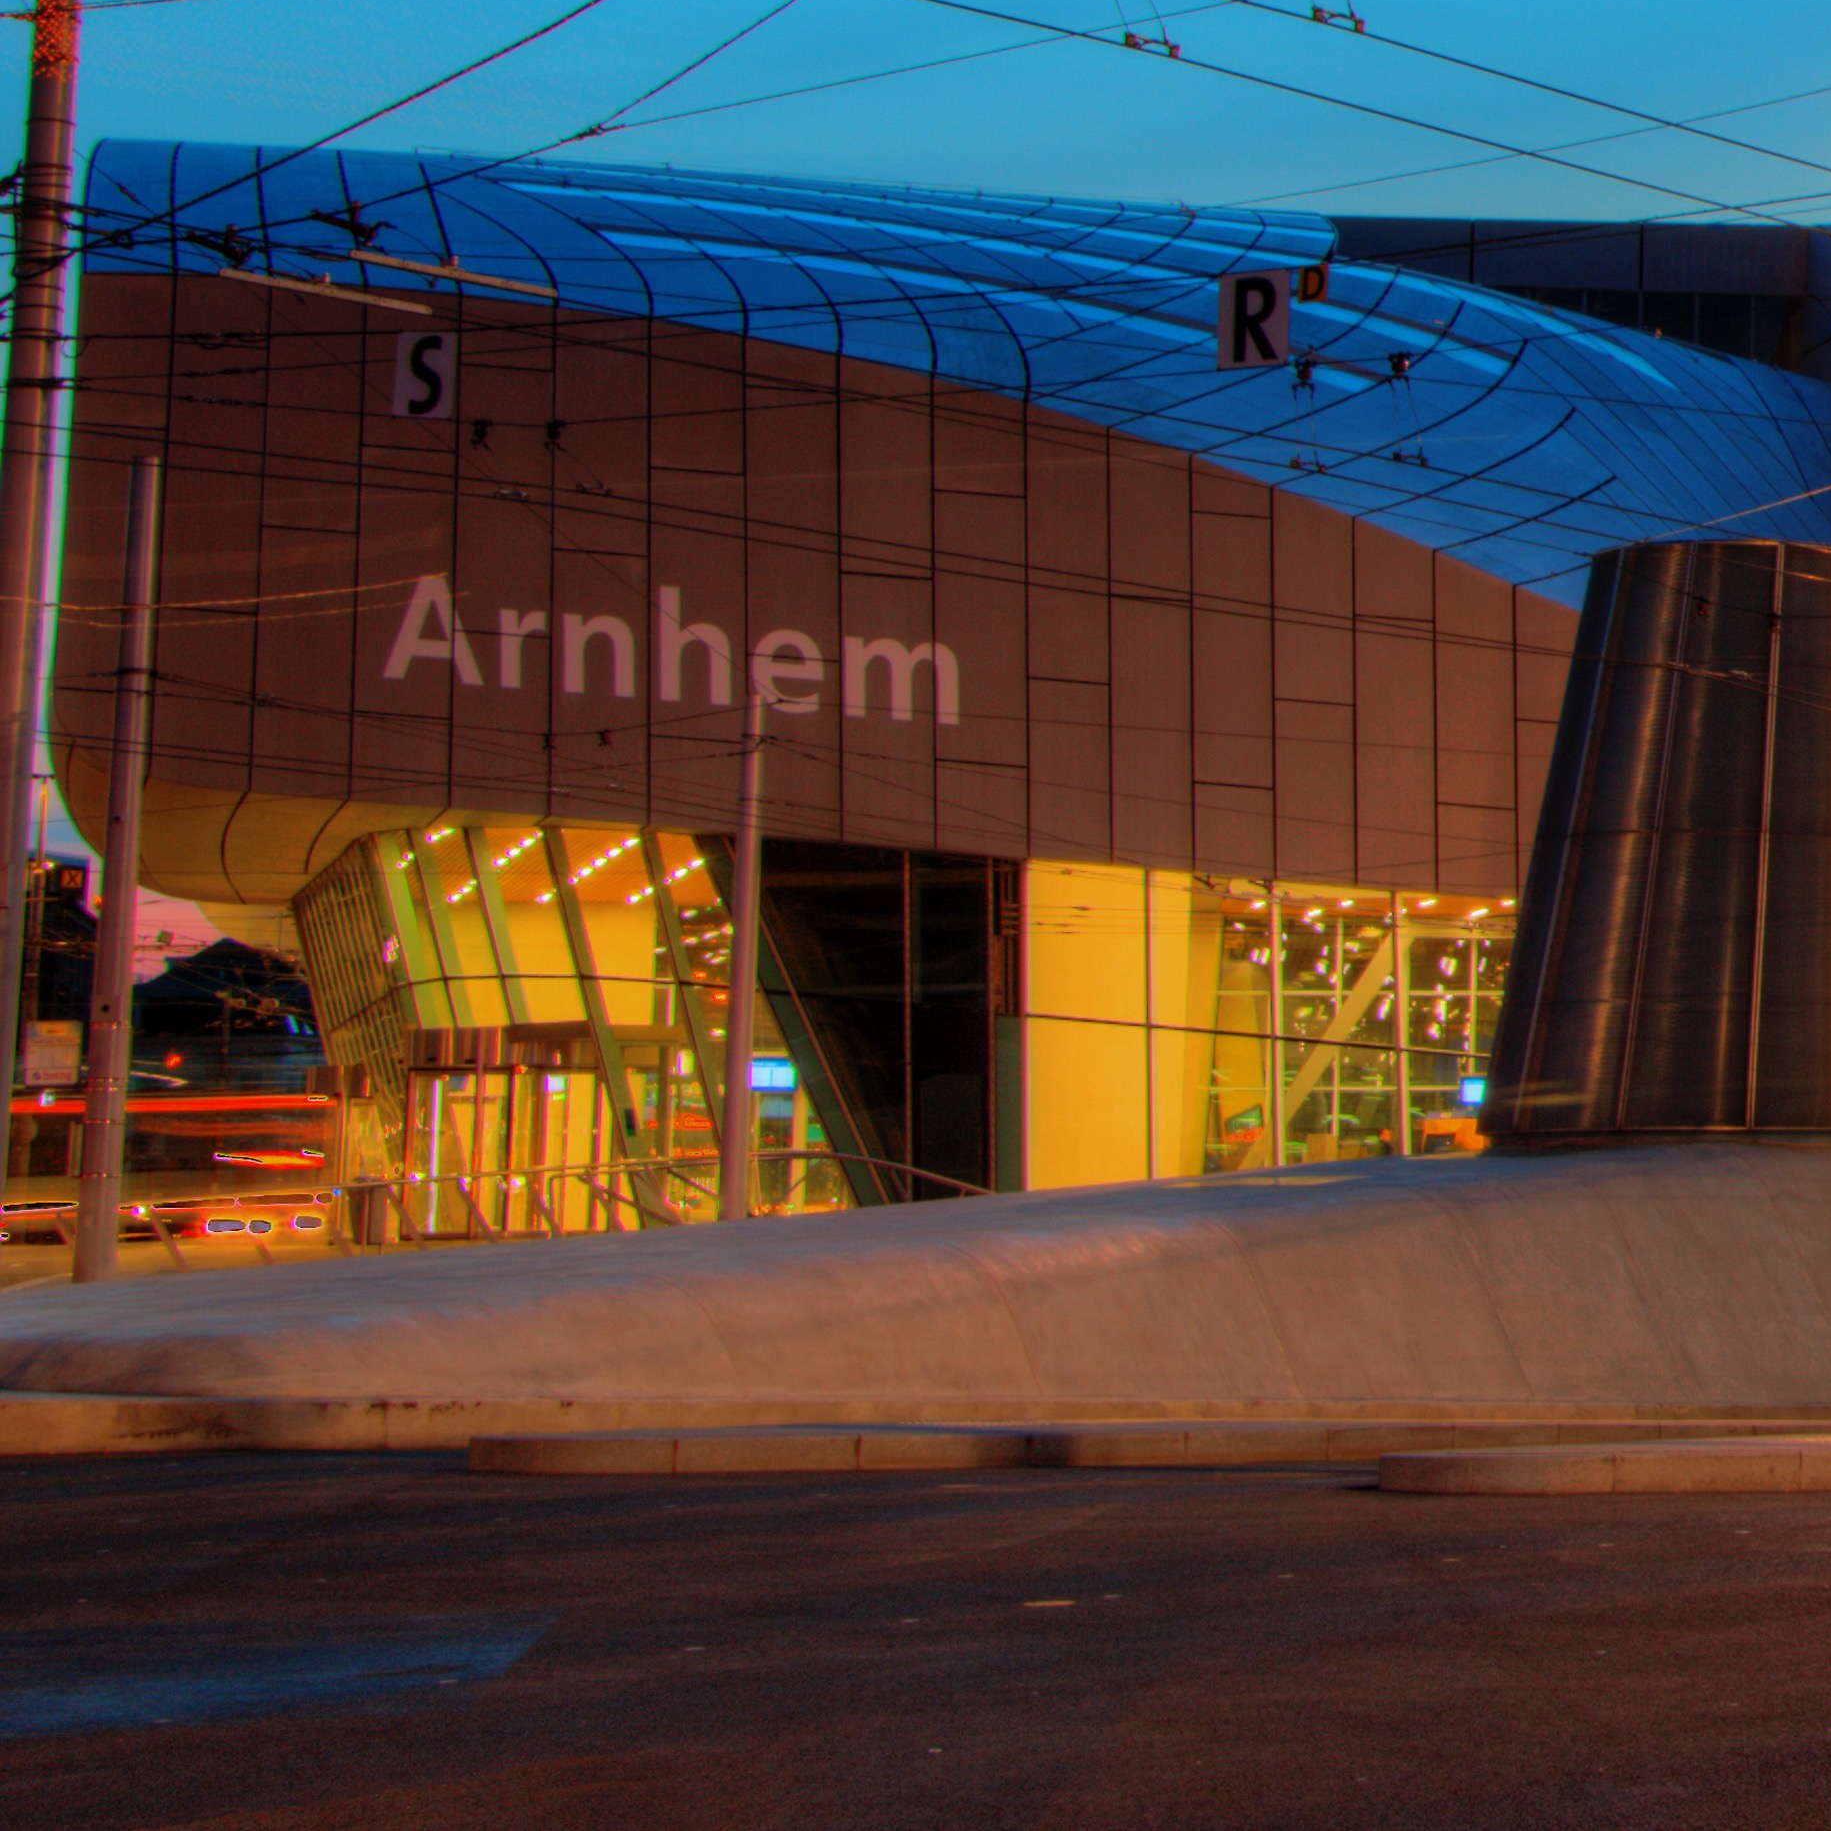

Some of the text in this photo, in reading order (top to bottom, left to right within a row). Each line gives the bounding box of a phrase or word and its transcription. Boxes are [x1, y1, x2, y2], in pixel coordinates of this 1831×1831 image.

[1233, 277, 1279, 363] R
[1302, 266, 1324, 300] D
[408, 336, 443, 415] S
[383, 574, 960, 725] Arnhem
